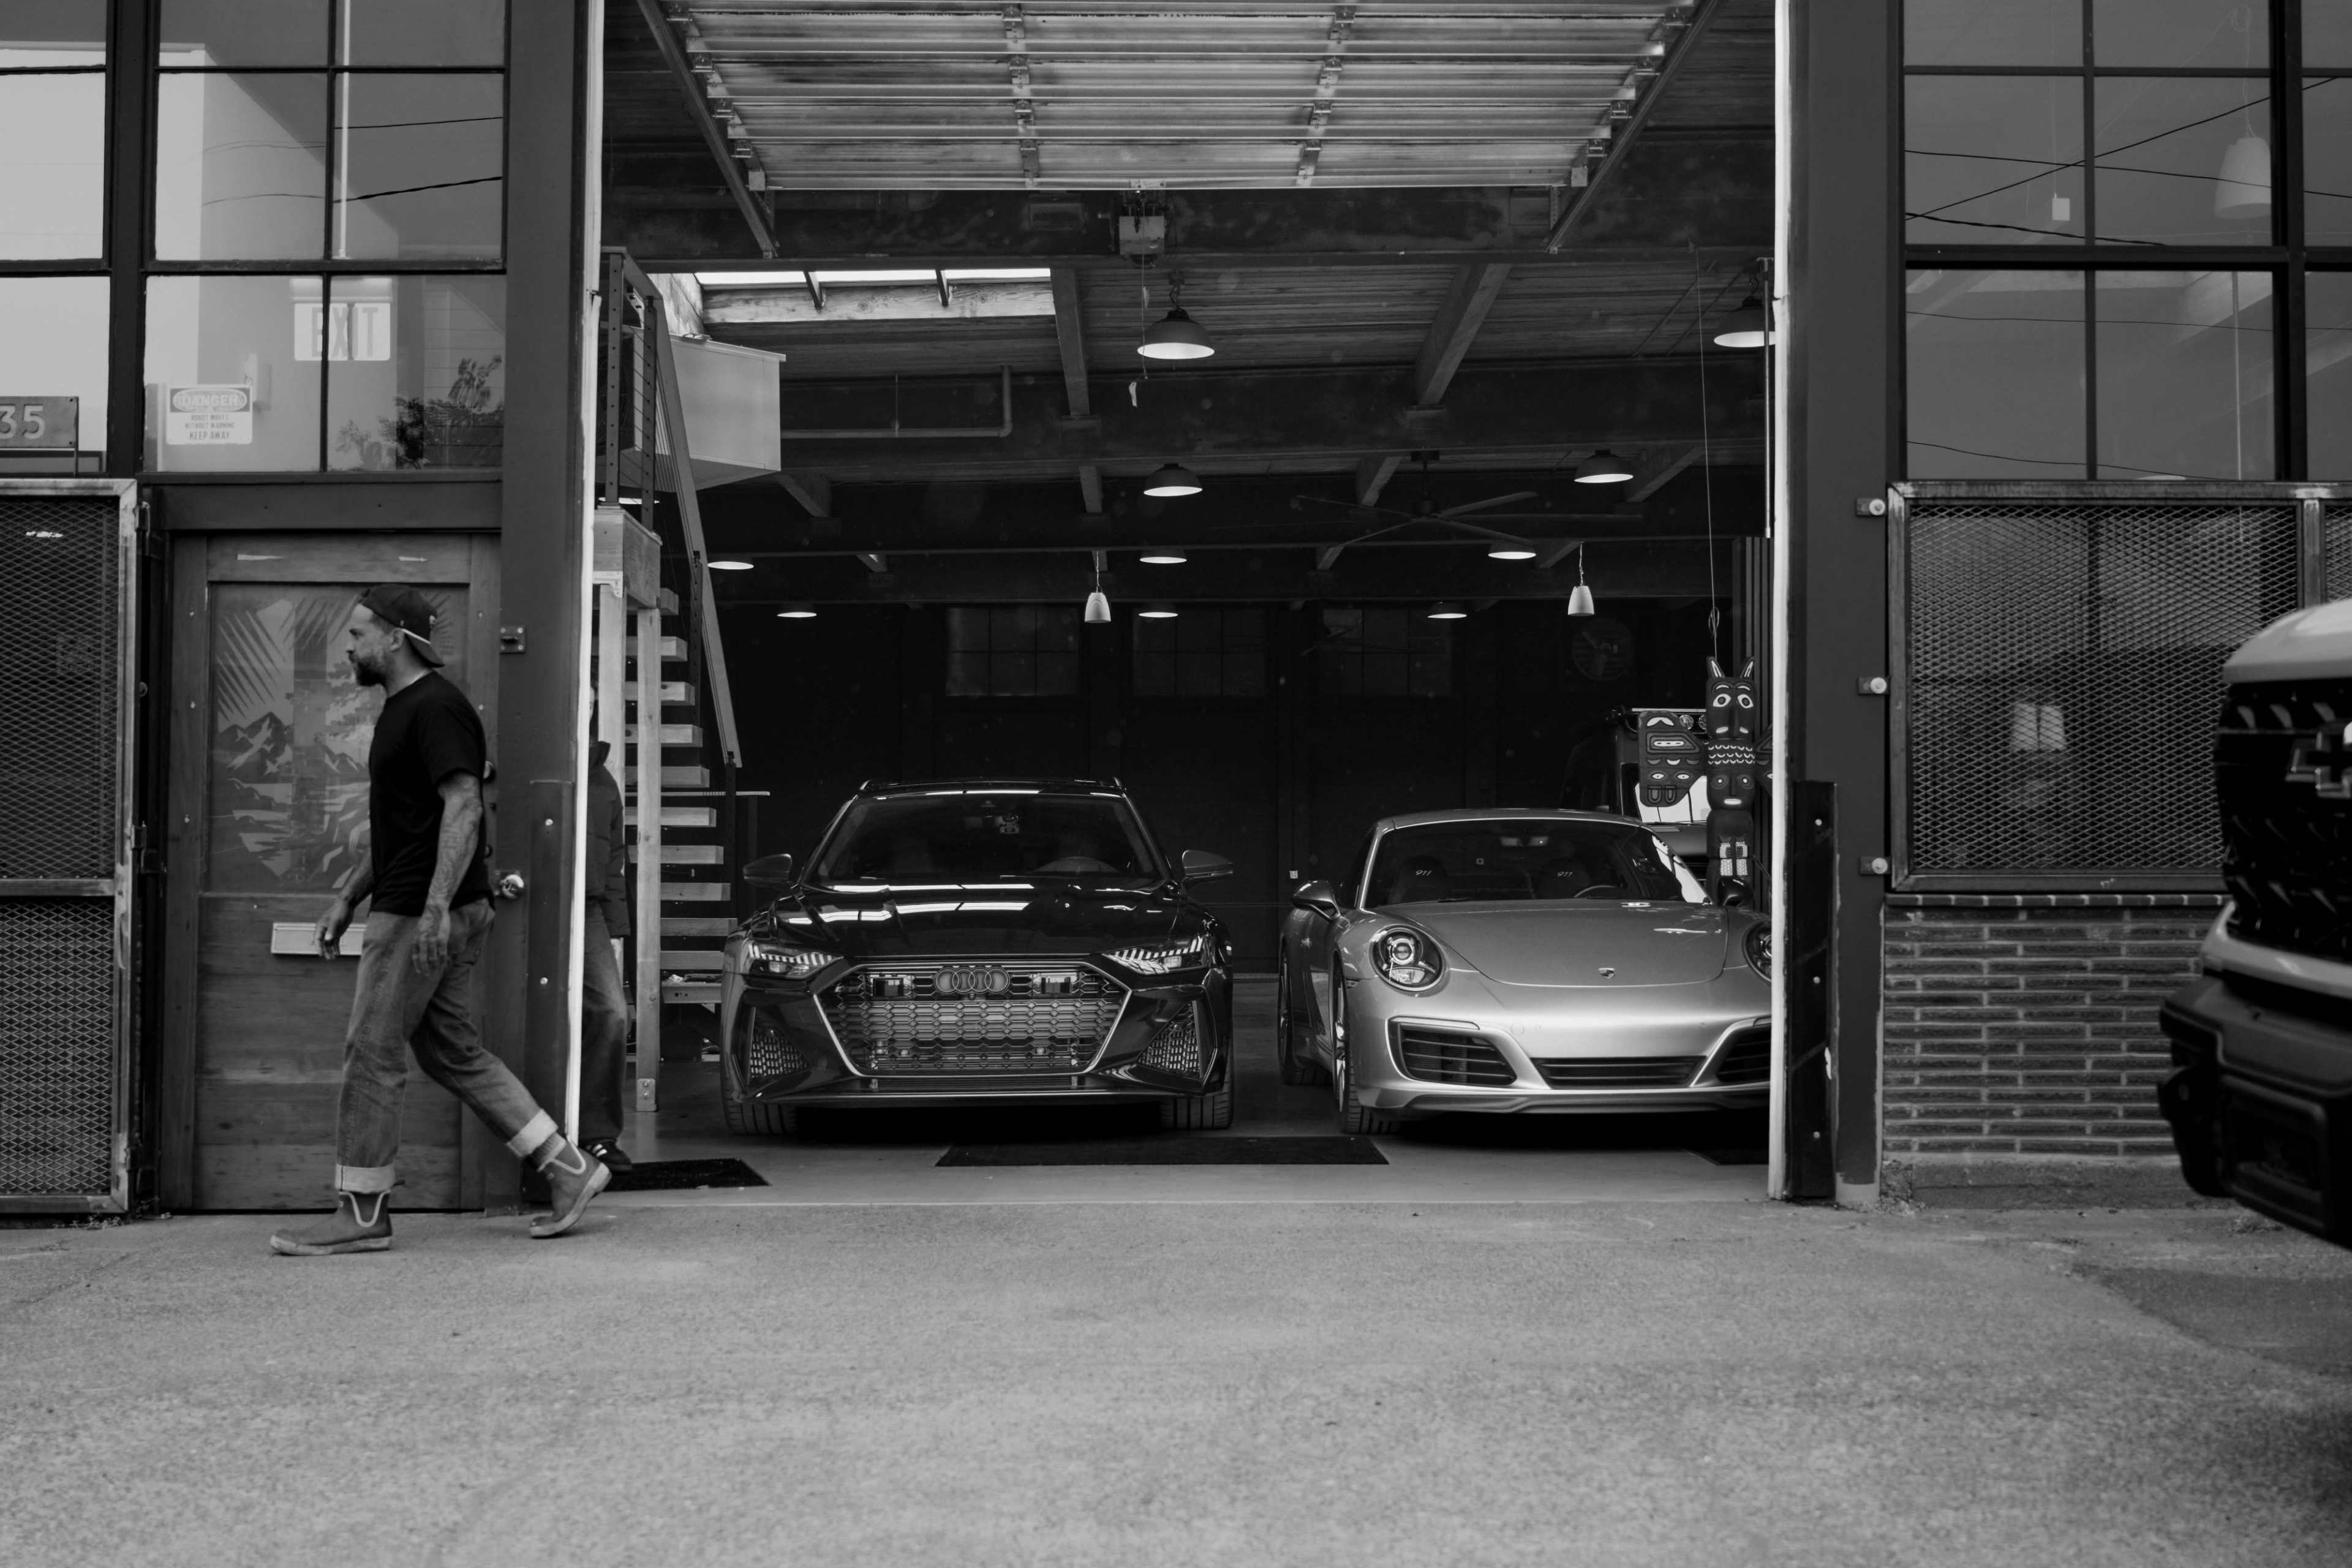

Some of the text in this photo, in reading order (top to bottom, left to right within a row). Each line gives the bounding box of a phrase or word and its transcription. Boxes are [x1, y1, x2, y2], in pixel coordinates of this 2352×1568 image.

[312, 307, 379, 357] EXIT
[181, 394, 239, 407] DANGER
[0, 404, 45, 440] 35
[190, 431, 230, 440] KEEP AWAY
